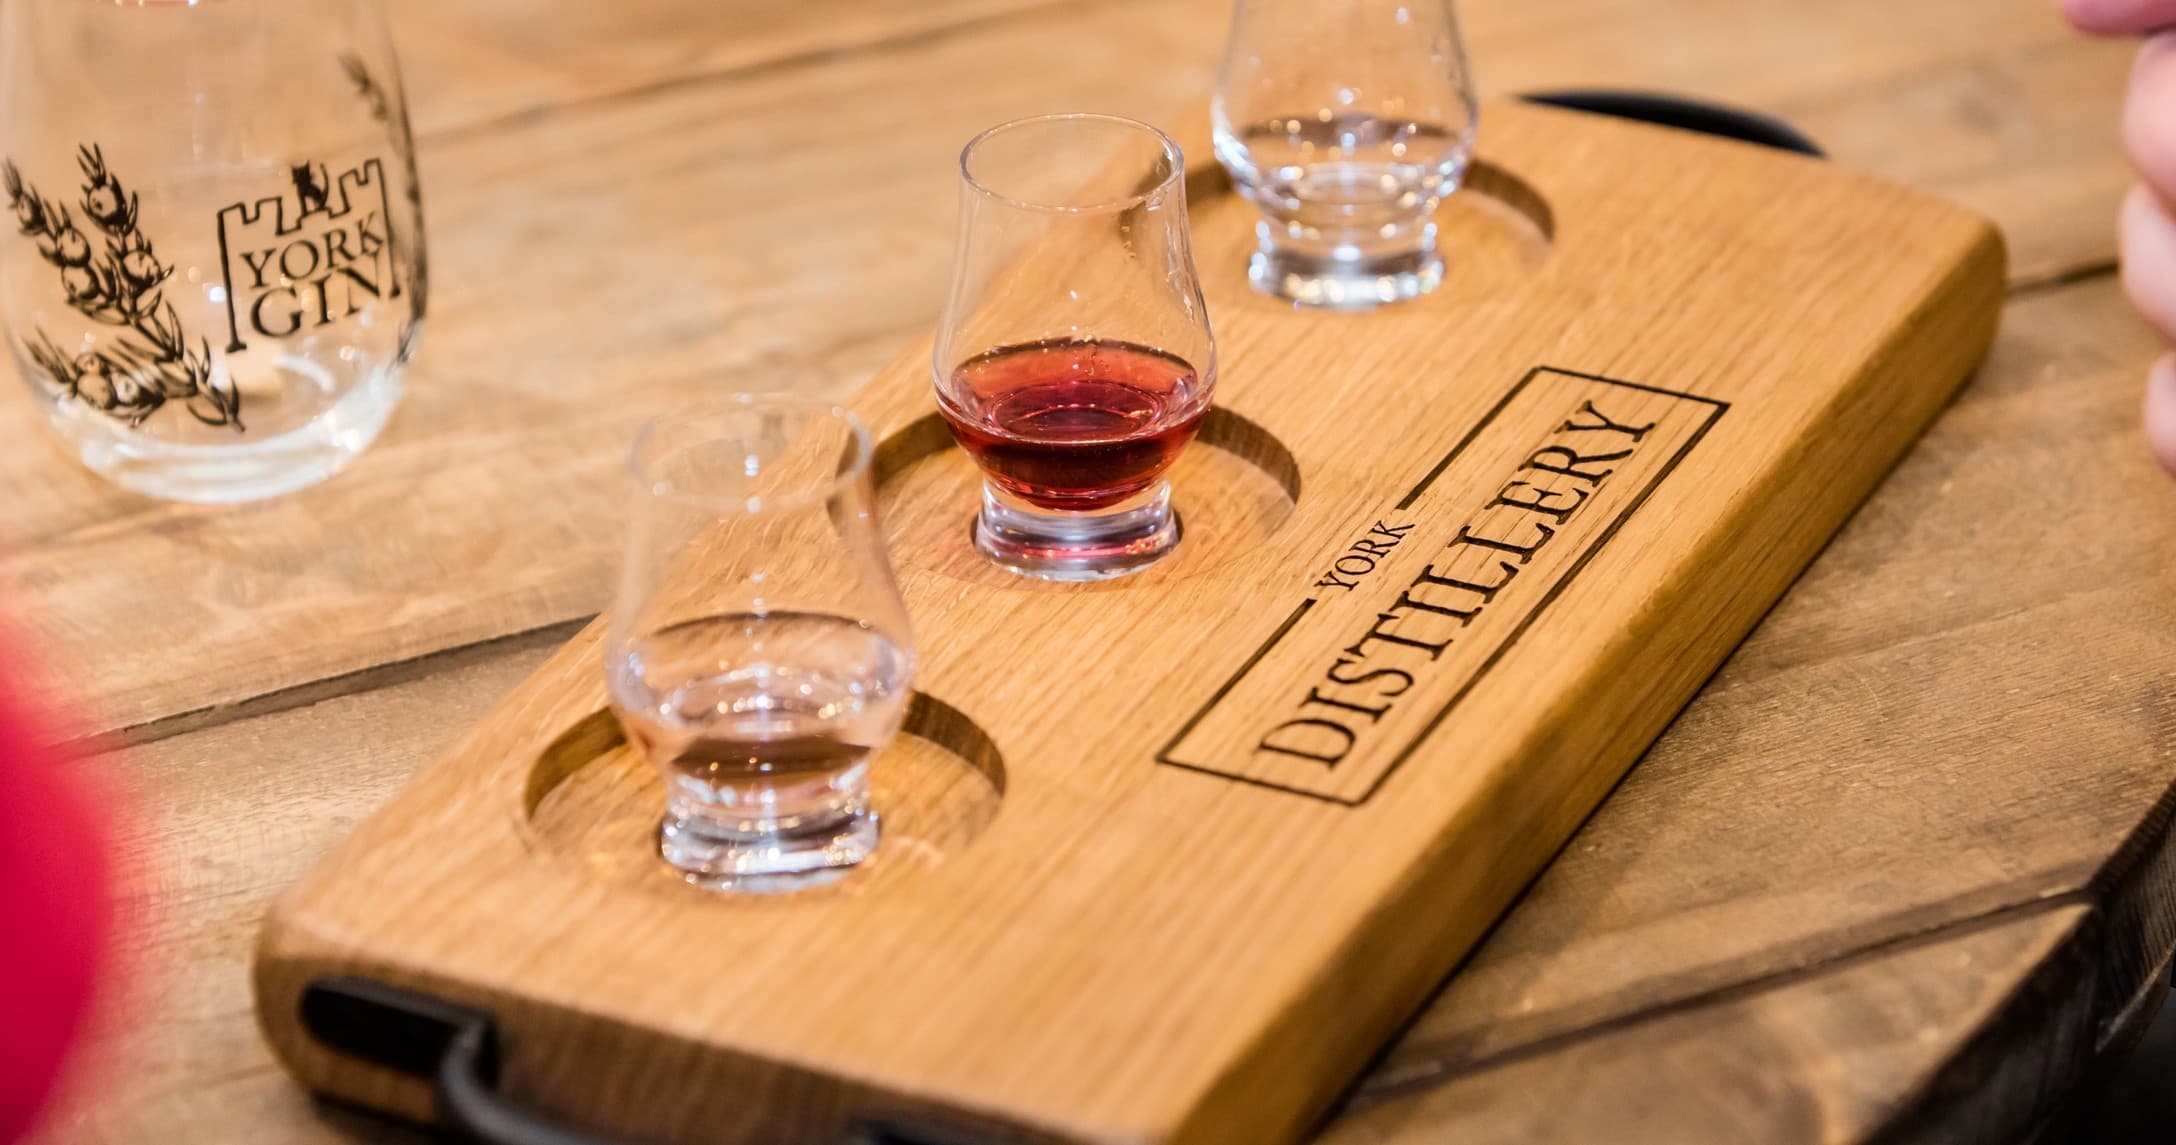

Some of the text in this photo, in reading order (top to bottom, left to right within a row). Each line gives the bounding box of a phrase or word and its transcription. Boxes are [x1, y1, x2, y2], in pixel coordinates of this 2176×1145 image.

[239, 213, 385, 288] YORK
[250, 256, 384, 338] GIN
[1255, 400, 1657, 769] DISTILLERY
[1315, 518, 1416, 593] YORK
